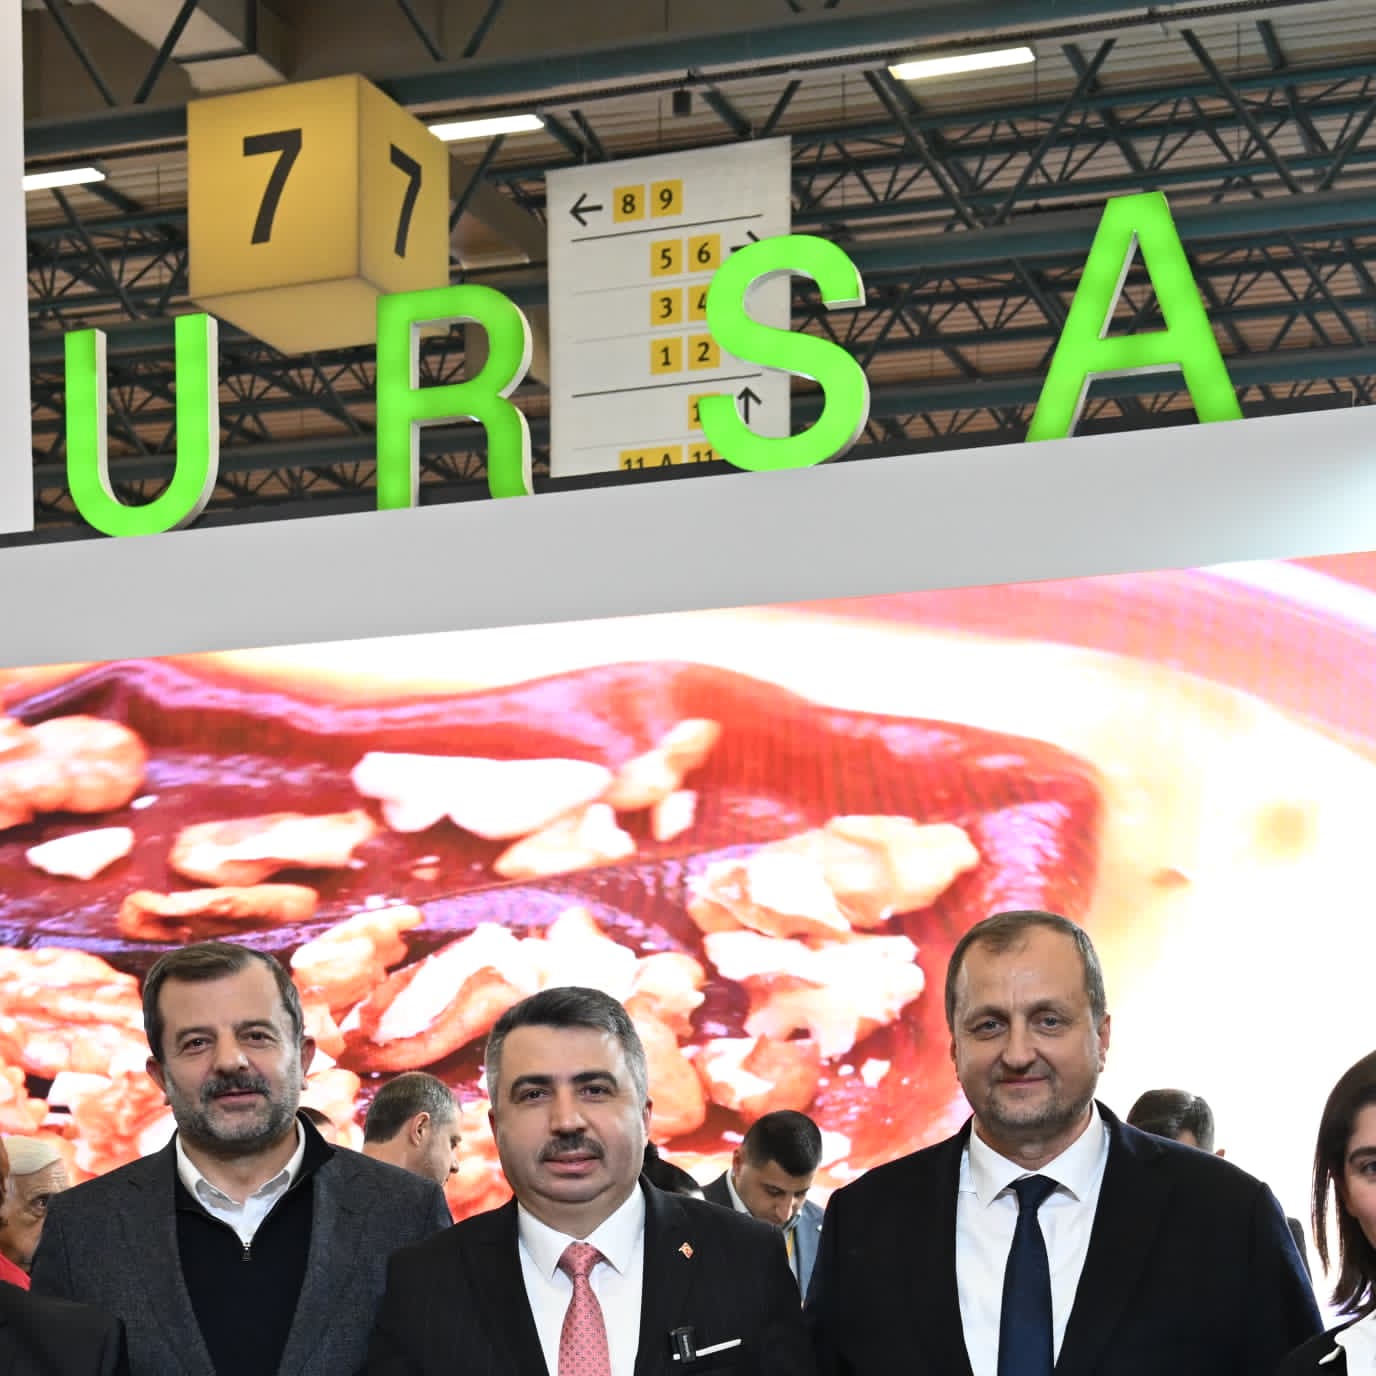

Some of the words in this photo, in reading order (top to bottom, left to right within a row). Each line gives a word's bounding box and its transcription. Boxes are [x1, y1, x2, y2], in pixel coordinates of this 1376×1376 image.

[242, 128, 304, 245] 7
[389, 143, 422, 259] 7
[621, 193, 636, 215] 8
[659, 188, 673, 210] 9
[660, 247, 673, 269] 5
[697, 242, 711, 264] 6
[660, 297, 673, 319] 3
[662, 346, 672, 366] 1
[697, 341, 711, 362] 2
